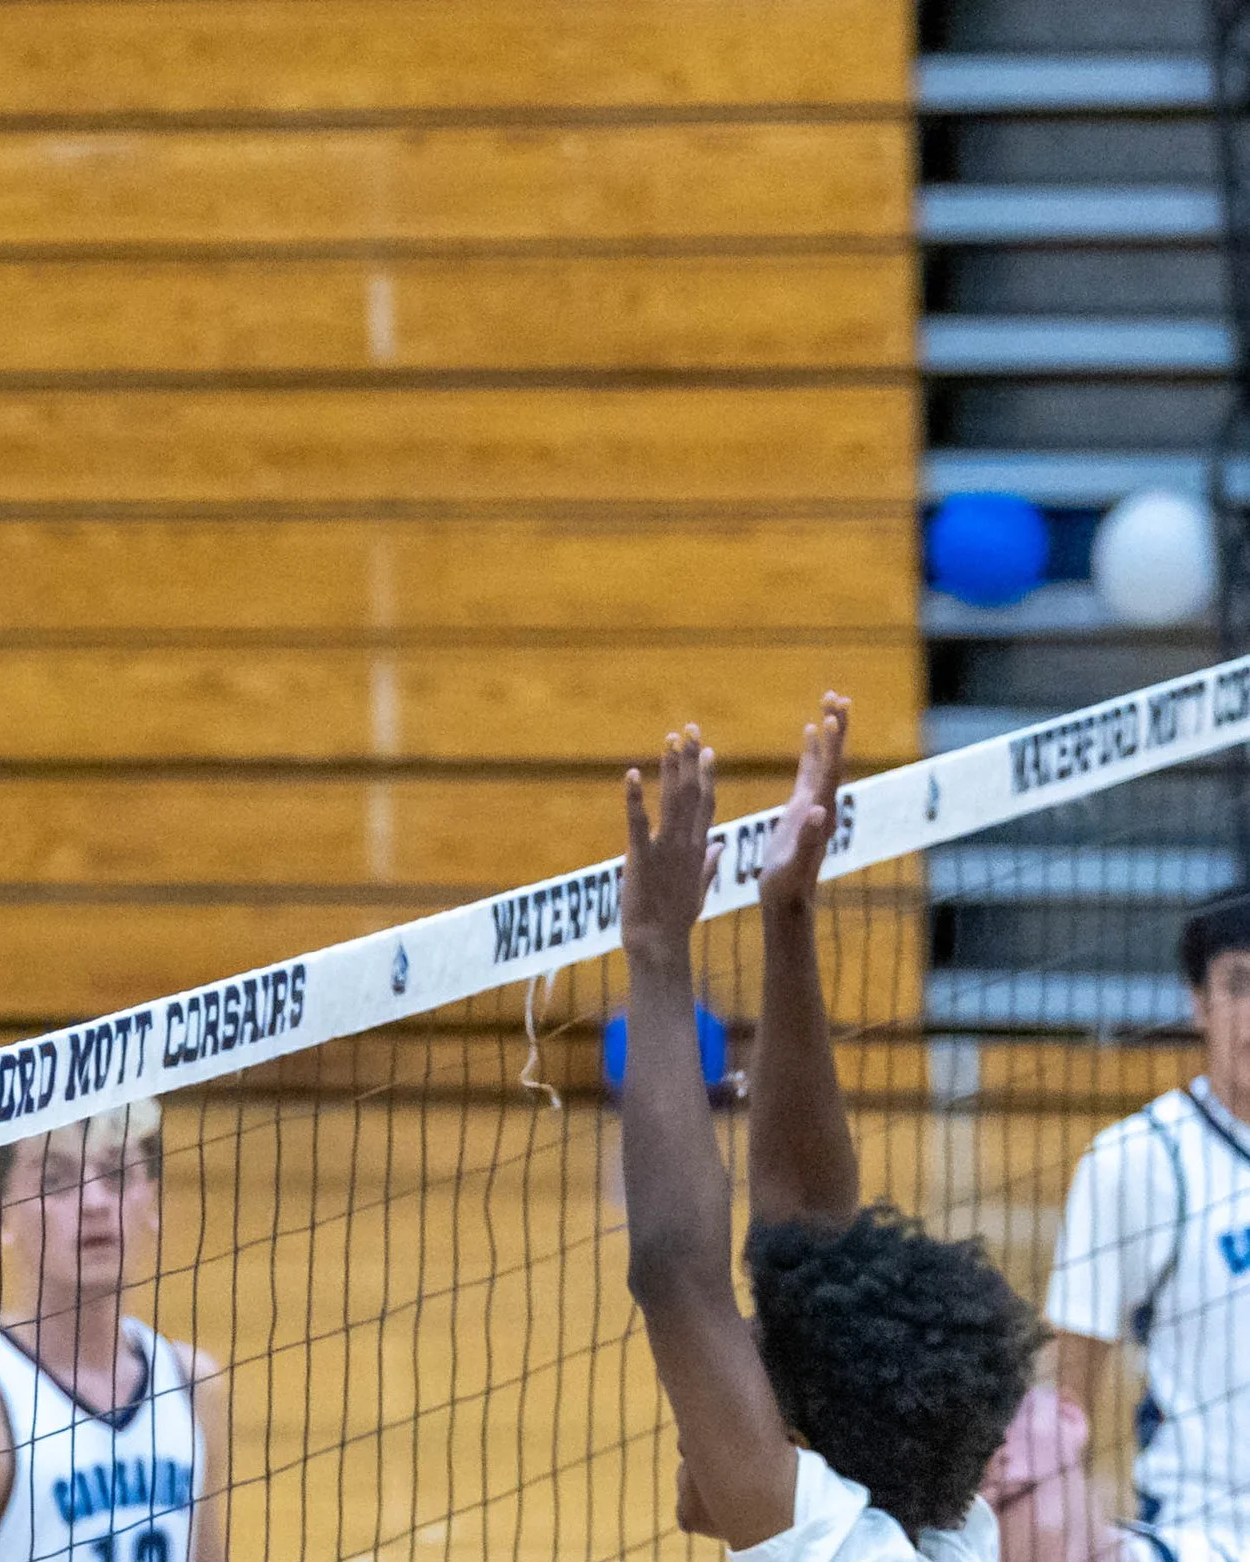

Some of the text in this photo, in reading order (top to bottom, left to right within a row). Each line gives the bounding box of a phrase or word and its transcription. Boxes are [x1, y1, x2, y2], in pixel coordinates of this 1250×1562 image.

[492, 865, 623, 964] WATERFO
[65, 1010, 153, 1101] MOTT
[162, 963, 306, 1069] CORSAIRS
